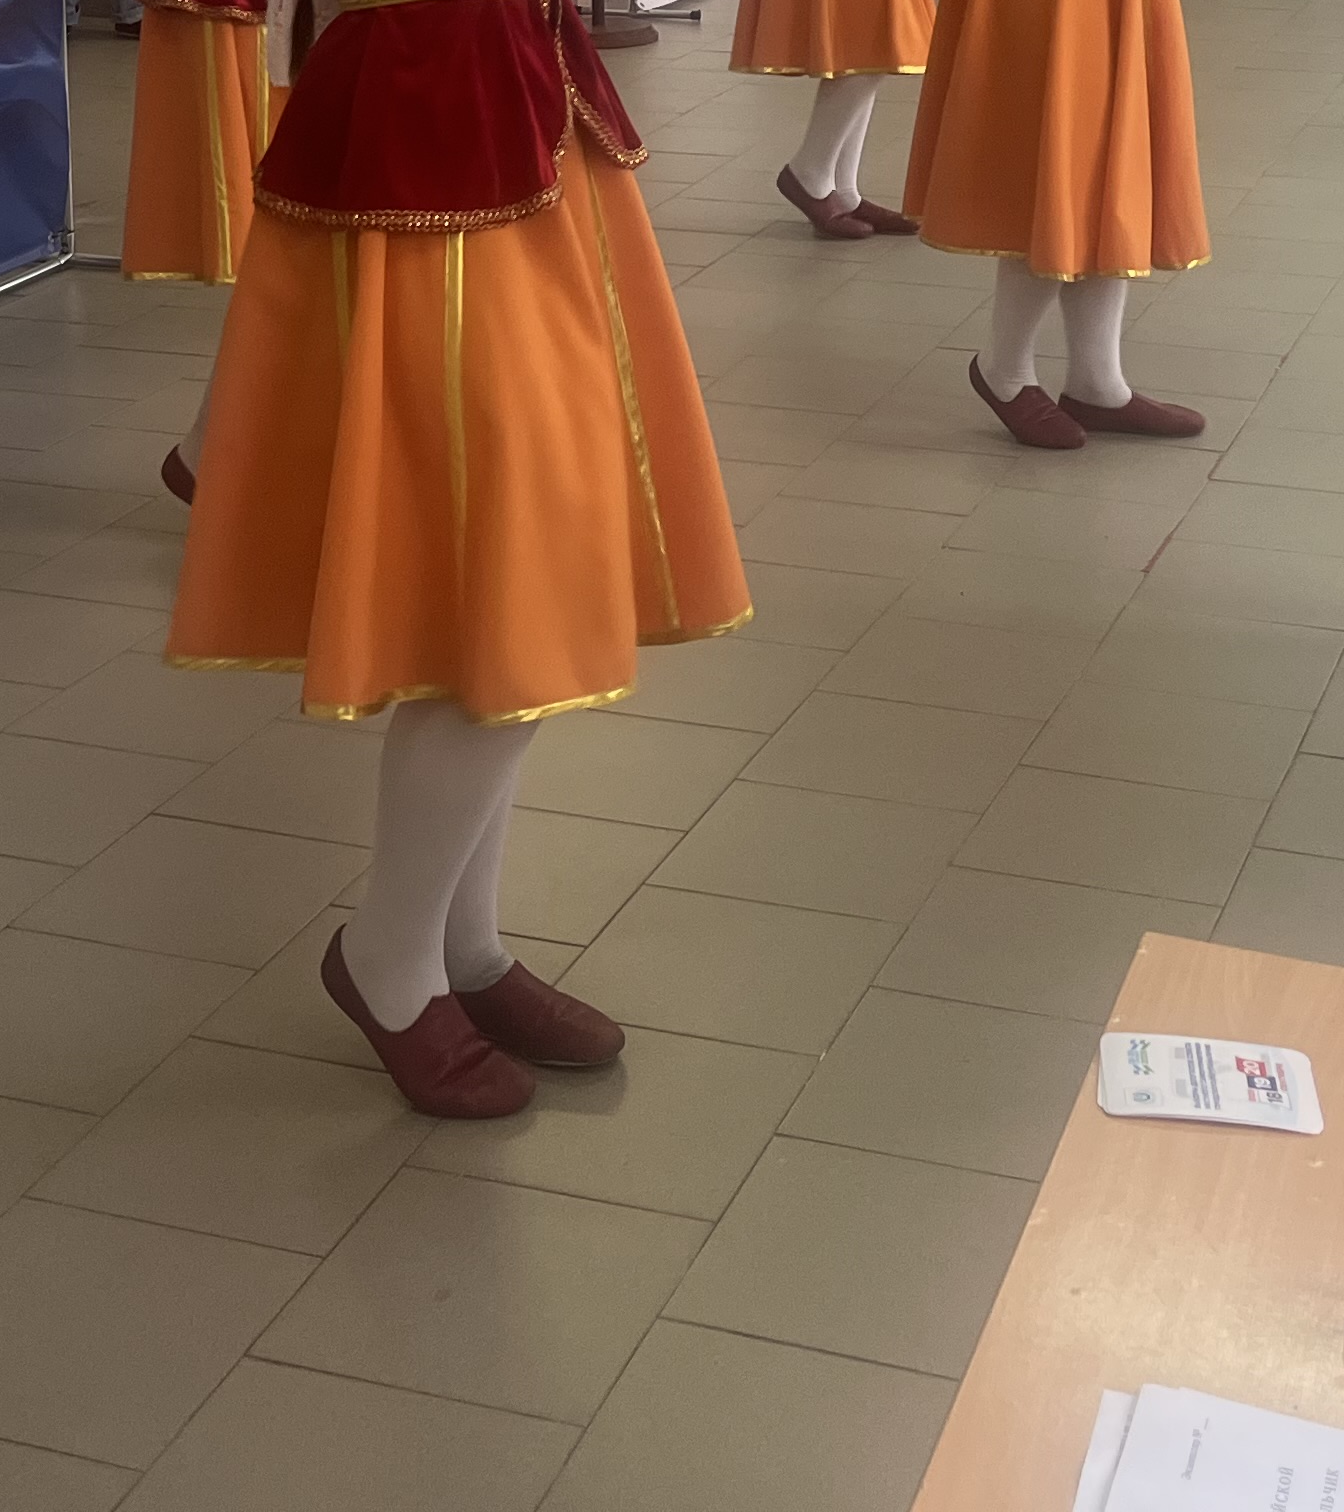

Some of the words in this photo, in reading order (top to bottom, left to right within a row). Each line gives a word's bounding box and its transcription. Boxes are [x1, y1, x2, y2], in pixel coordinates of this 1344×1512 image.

[1244, 1059, 1261, 1076] 20
[1272, 1466, 1294, 1512] ЙСКОЙ
[1317, 1467, 1340, 1512] ЛЬЧИК
